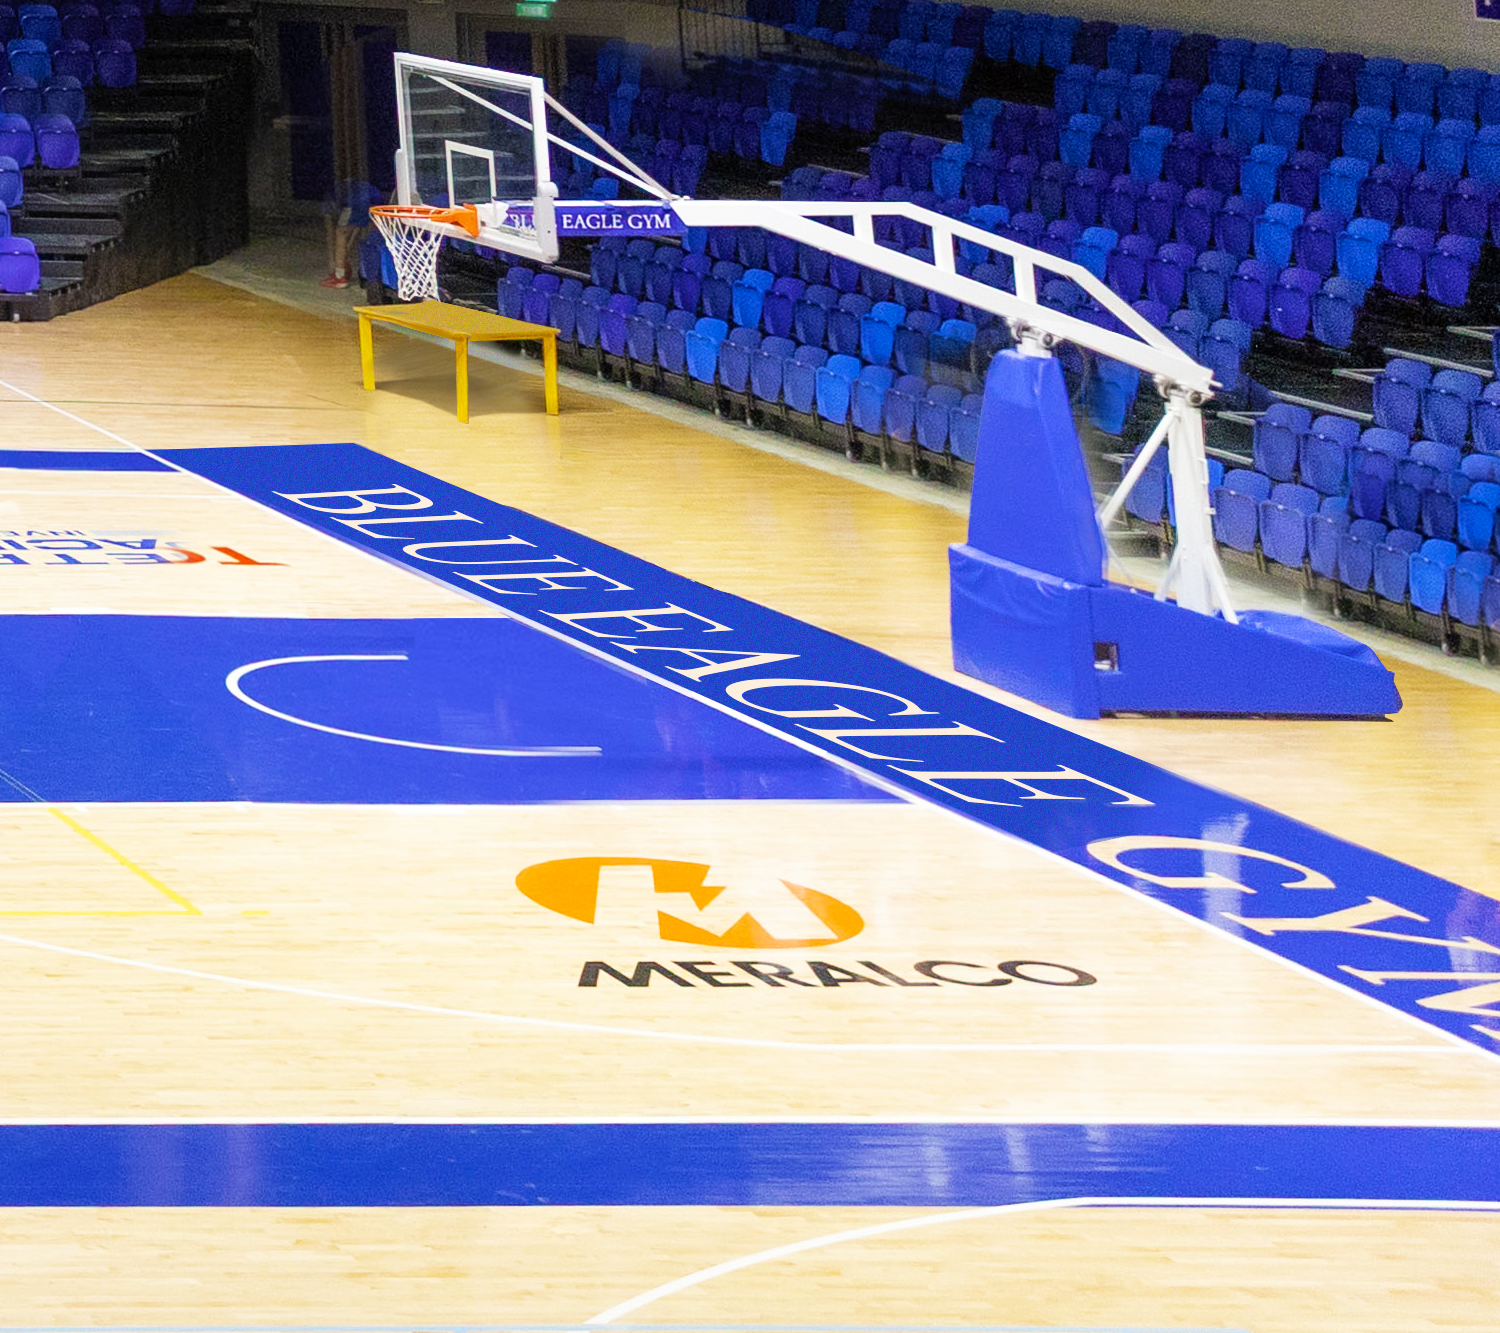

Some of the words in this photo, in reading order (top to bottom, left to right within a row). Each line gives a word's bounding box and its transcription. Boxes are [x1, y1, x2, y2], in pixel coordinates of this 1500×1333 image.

[562, 214, 623, 230] EAGLE
[627, 213, 671, 230] GYM
[272, 482, 635, 596] BLUE
[539, 601, 1157, 809] EAGLE
[577, 960, 1098, 988] MERALCO
